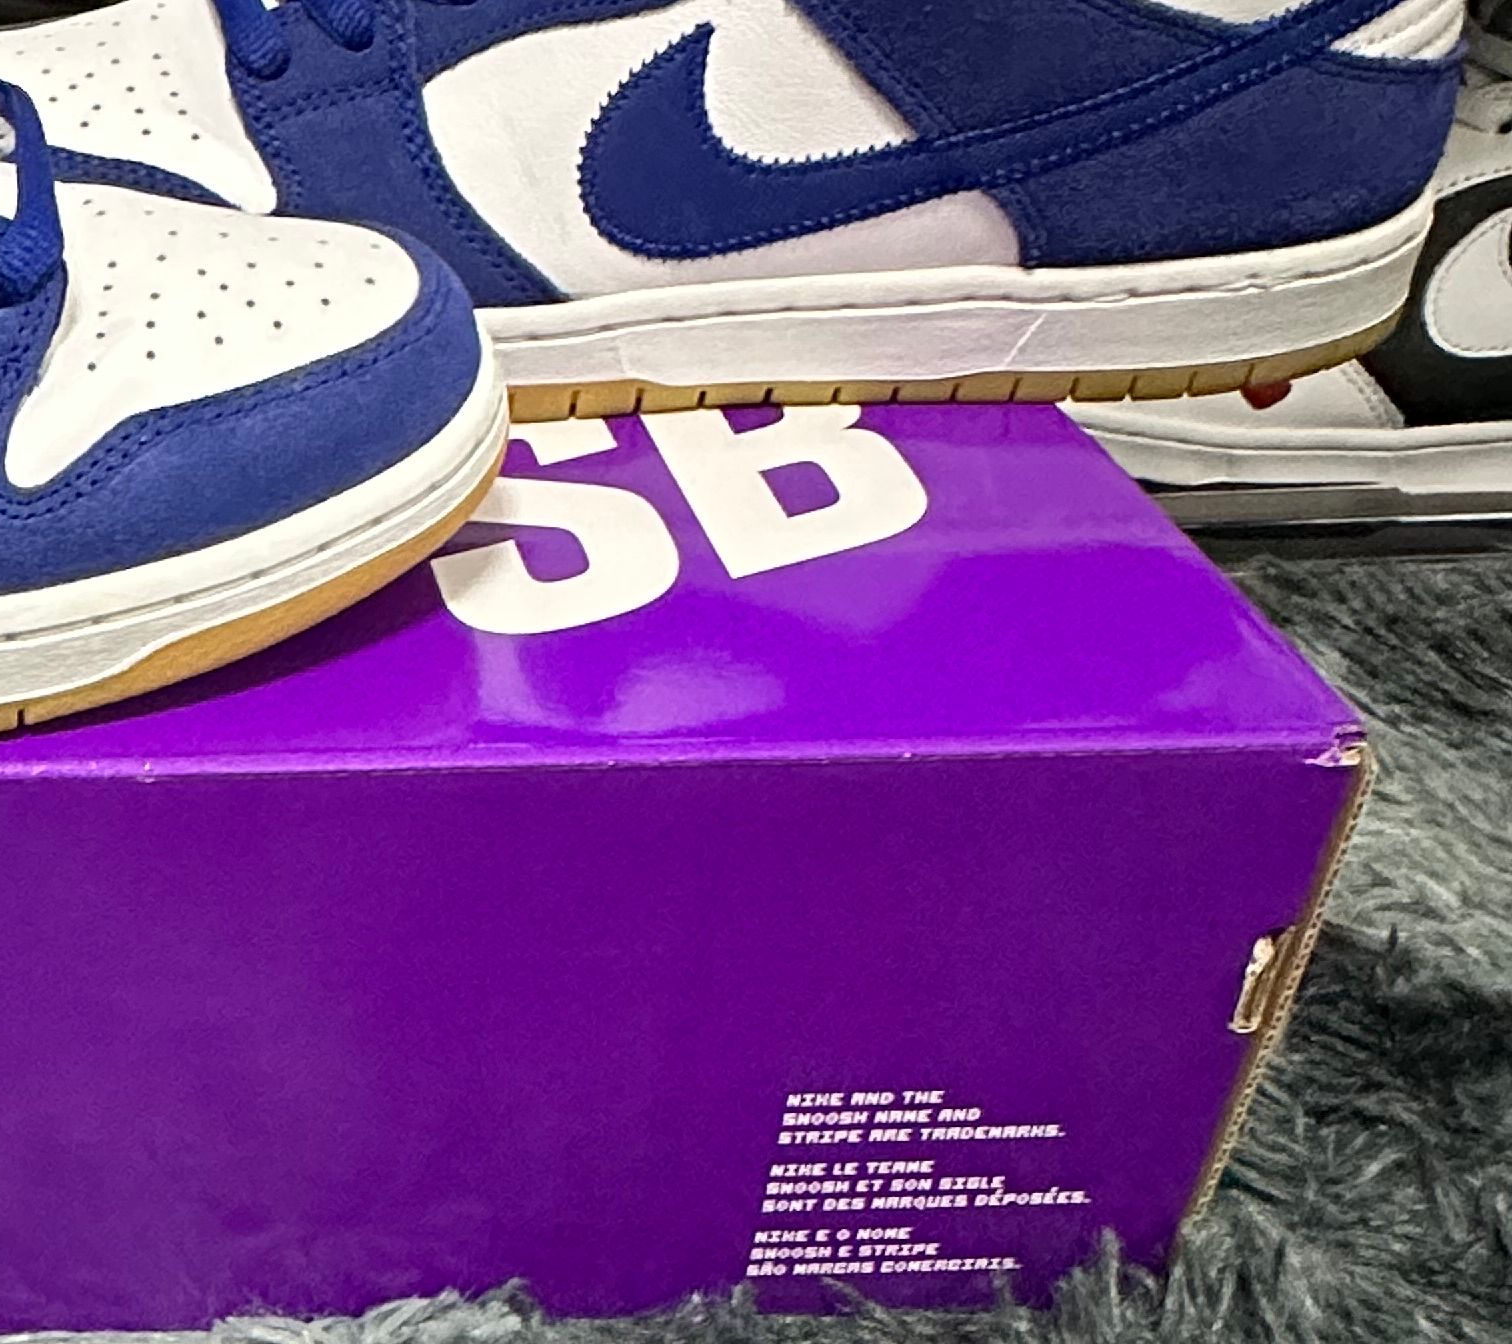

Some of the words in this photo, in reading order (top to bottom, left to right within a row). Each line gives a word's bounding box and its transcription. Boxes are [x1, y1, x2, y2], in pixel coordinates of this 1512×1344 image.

[431, 405, 929, 635] SB
[786, 1093, 845, 1108] NIKE
[850, 1091, 896, 1106] AND
[902, 1090, 945, 1105] THE
[782, 1110, 869, 1126] SWOOSH
[874, 1109, 934, 1124] NAME
[937, 1107, 982, 1122] AND
[778, 1129, 865, 1145] STRIPE
[868, 1128, 914, 1142] ARE
[769, 1162, 828, 1177] NIKE
[832, 1162, 860, 1176] LE
[766, 1180, 851, 1195] SWOOSH
[855, 1179, 884, 1193] ET
[888, 1178, 934, 1192] SON
[761, 1198, 819, 1213] SONT
[822, 1198, 867, 1211] DES
[870, 1195, 968, 1210] MARQUES
[753, 1230, 812, 1244] NIKE
[858, 1242, 942, 1257] STRIPE
